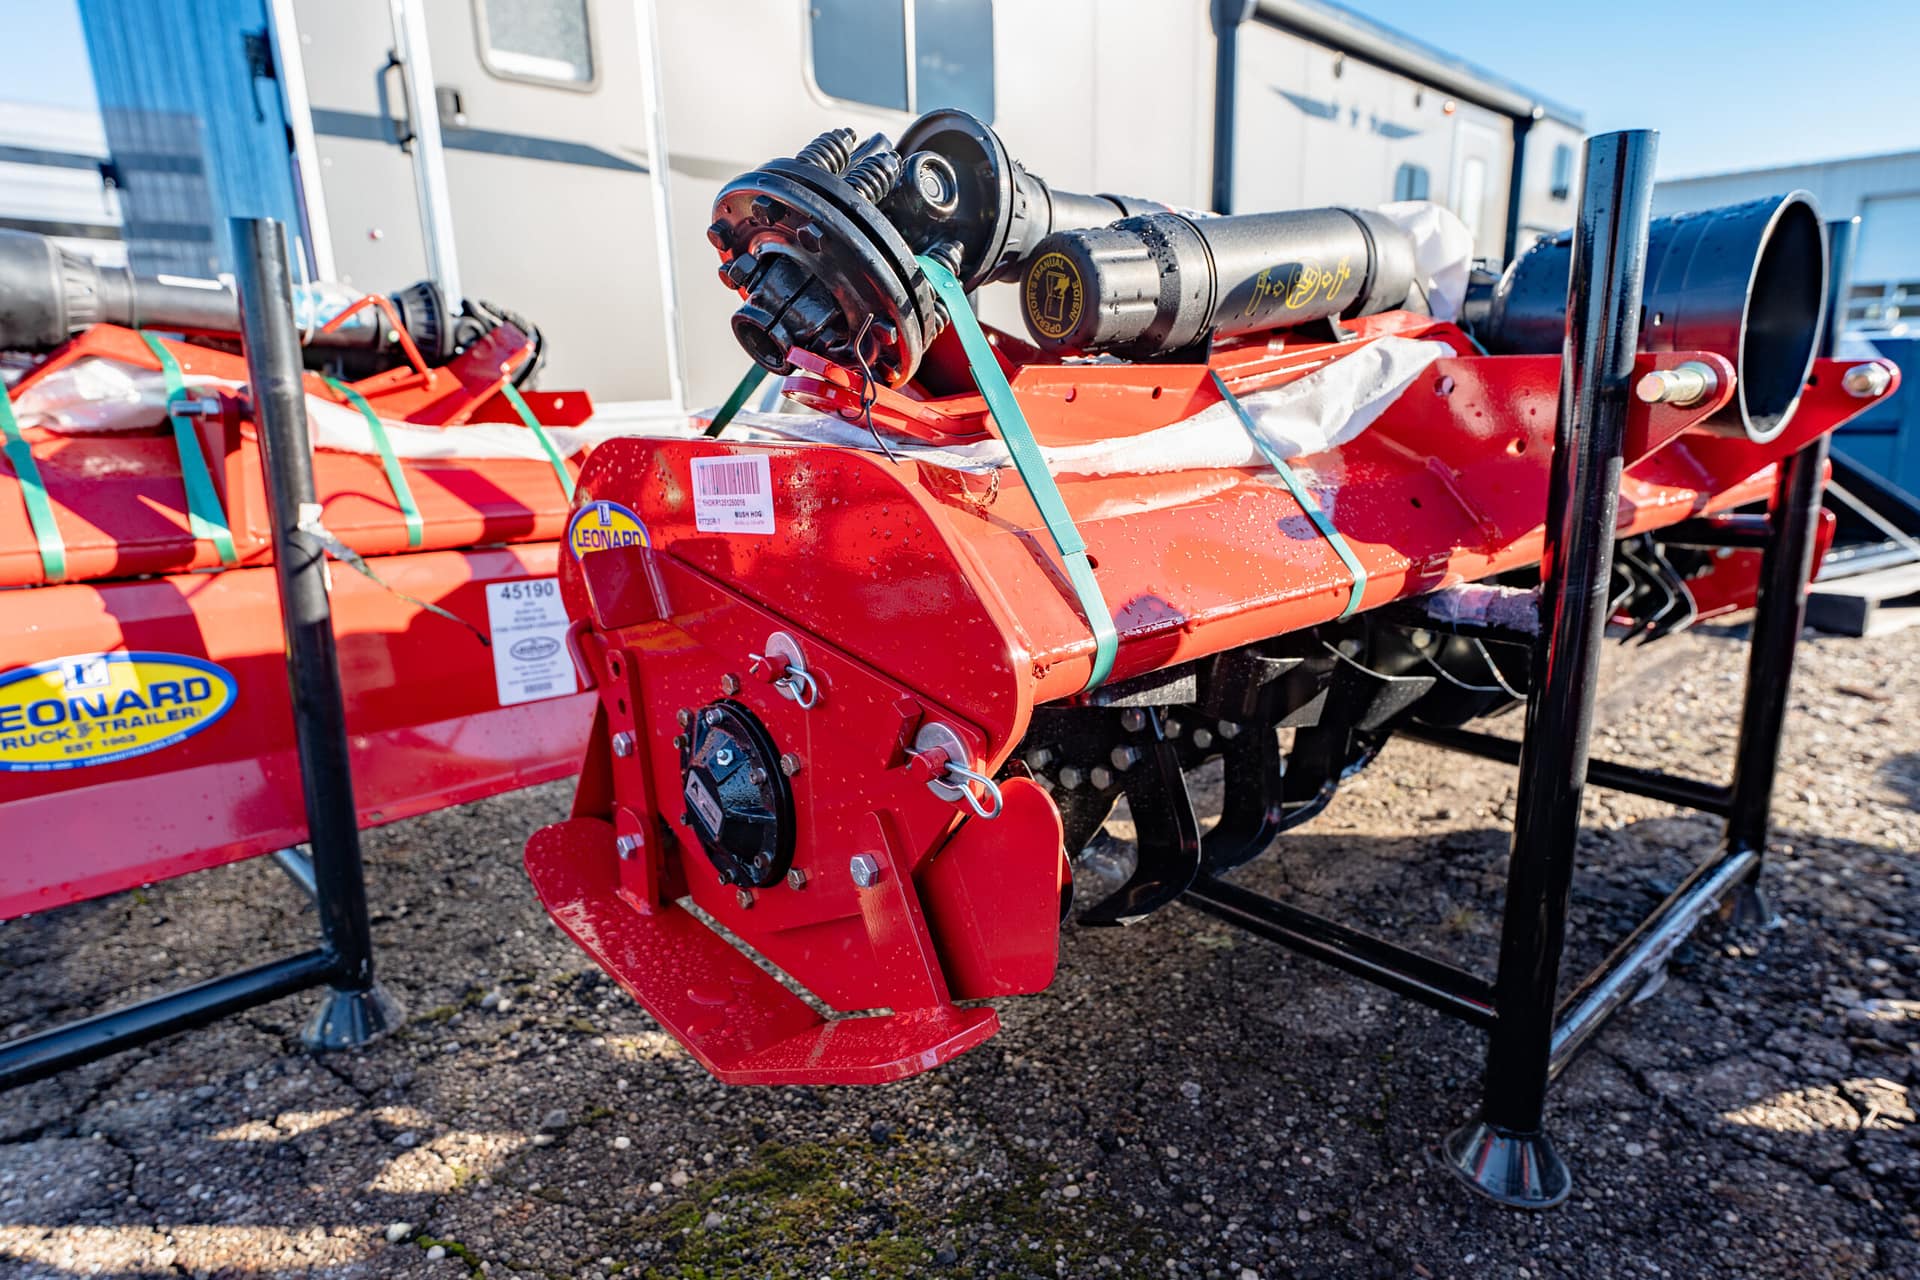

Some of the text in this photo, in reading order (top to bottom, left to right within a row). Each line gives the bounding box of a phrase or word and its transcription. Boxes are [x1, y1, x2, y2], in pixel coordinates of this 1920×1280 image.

[1034, 256, 1065, 279] MANUAL
[1069, 280, 1080, 321] INSIDE
[750, 510, 763, 518] HOG
[575, 529, 642, 549] LEONARD
[501, 581, 554, 600] 45190
[96, 707, 196, 734] TRAILER
